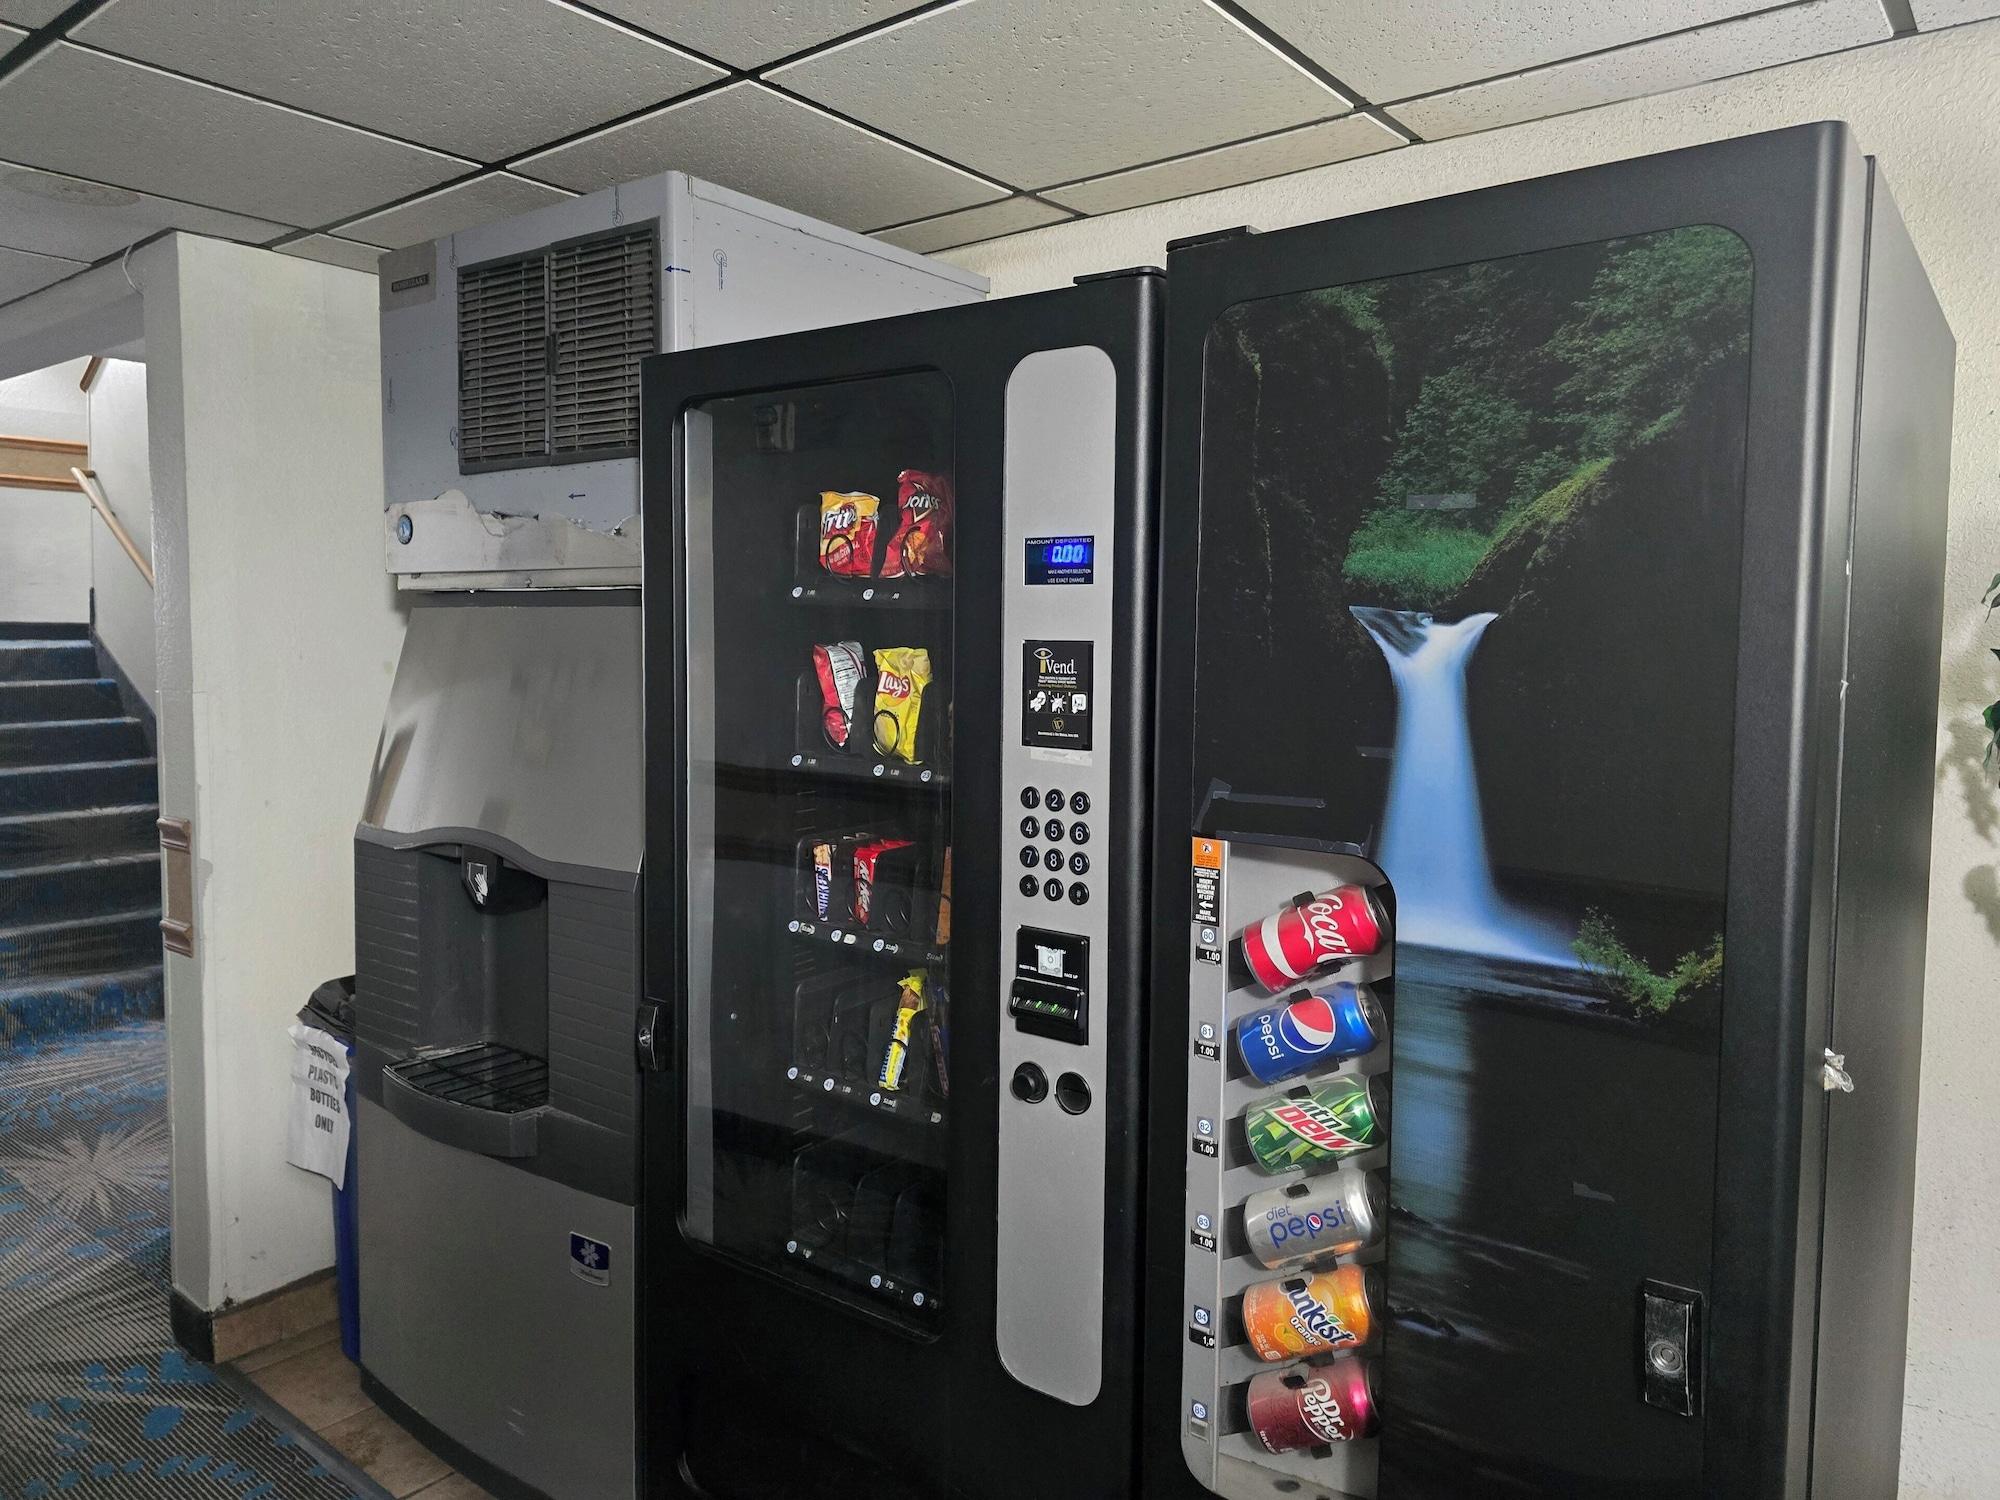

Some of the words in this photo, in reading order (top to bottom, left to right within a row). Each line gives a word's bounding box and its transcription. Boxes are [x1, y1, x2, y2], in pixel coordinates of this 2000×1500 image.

[1027, 538, 1054, 546] AMOUNT
[1027, 791, 1033, 805] 1
[1051, 794, 1058, 807] 2
[1075, 796, 1084, 810] 3
[1025, 821, 1033, 835] 4
[1050, 824, 1058, 837] 5
[1075, 826, 1084, 841] 6
[1025, 850, 1033, 864] 7
[1050, 853, 1057, 867] 8
[1075, 856, 1083, 871] 9
[1050, 883, 1057, 897] 0
[1205, 951, 1221, 962] 1.00
[1258, 1014, 1285, 1060] pepsi
[1200, 1044, 1214, 1056] 1.00
[310, 1087, 341, 1114] BOTTLES
[314, 1113, 335, 1134] ONLY
[1199, 1142, 1214, 1155] 1.00
[1266, 1205, 1293, 1221] diet
[1269, 1200, 1347, 1249] pepsi
[1199, 1235, 1214, 1248] 1.00
[1196, 1310, 1207, 1322] 84
[1288, 1288, 1355, 1345] unkist
[1290, 1317, 1322, 1347] Orange
[1194, 1404, 1205, 1416] 85
[1300, 1378, 1347, 1441] Pepper
[1322, 1400, 1345, 1428] Dr
